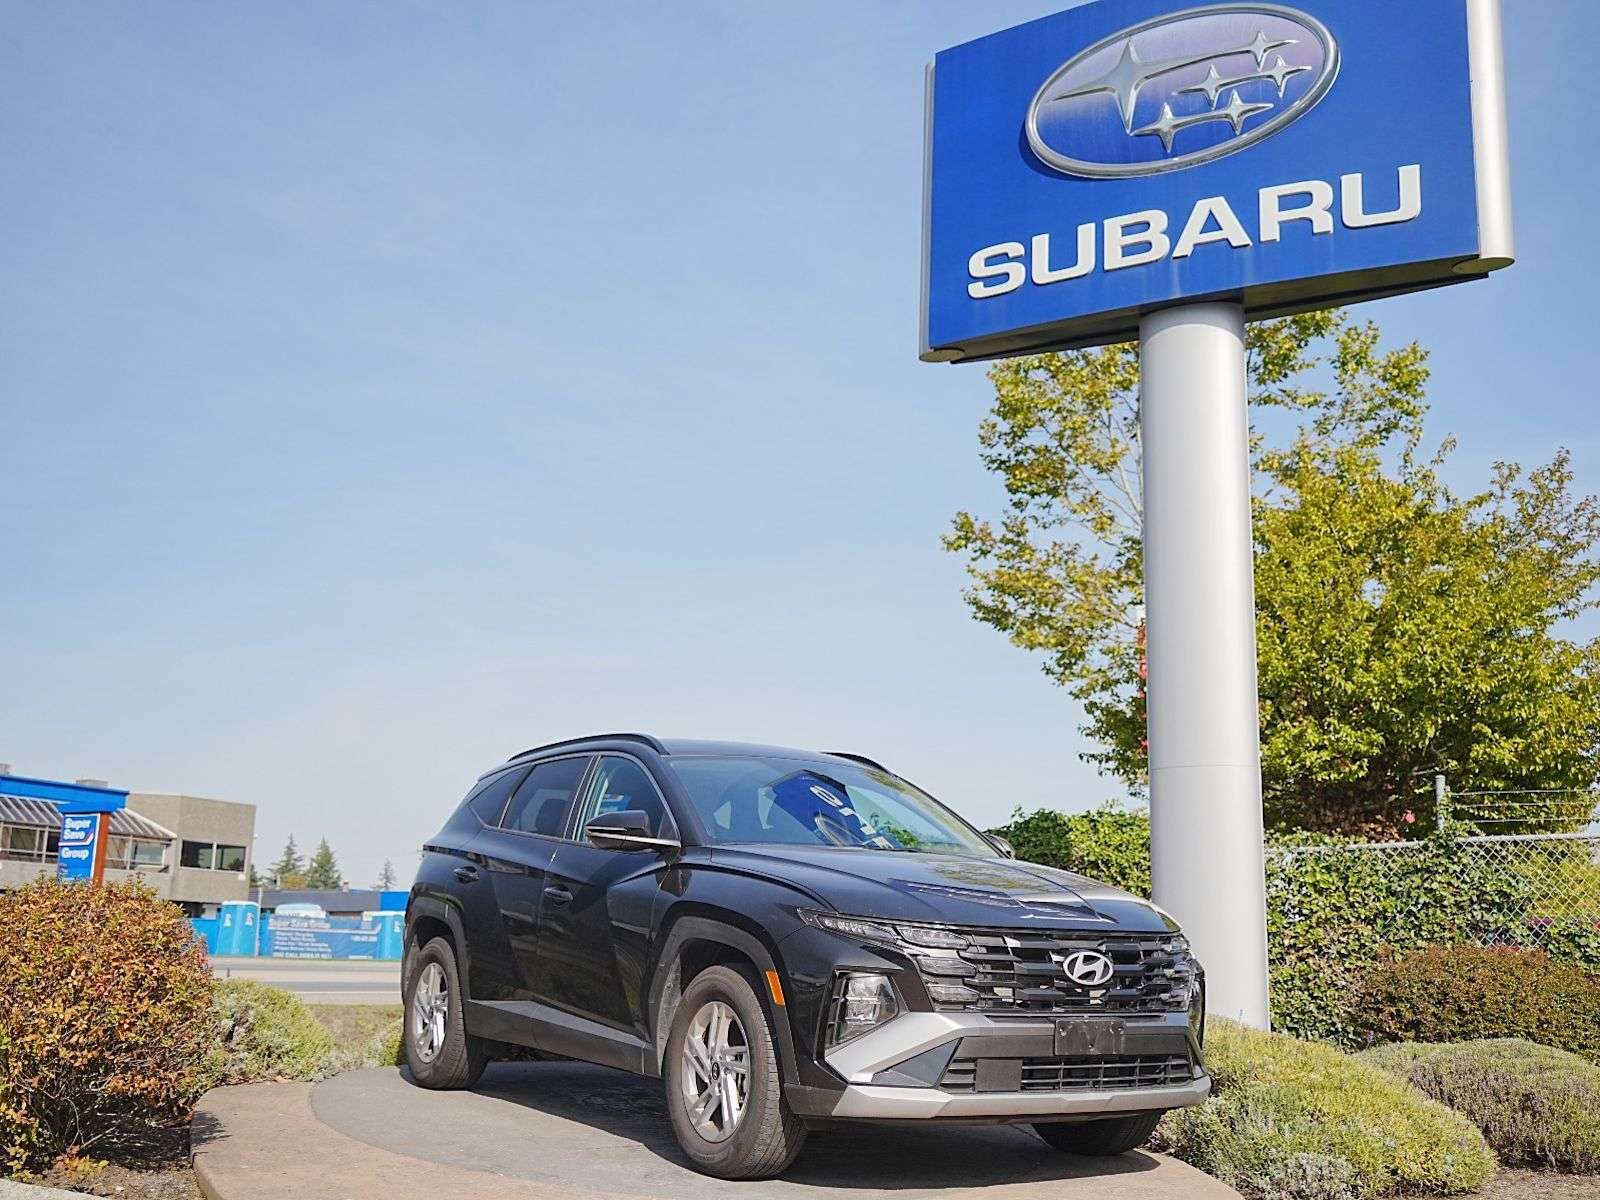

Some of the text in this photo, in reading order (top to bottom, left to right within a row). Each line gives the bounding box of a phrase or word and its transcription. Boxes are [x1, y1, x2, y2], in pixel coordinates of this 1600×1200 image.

[967, 164, 1422, 299] SUBARU
[65, 817, 92, 830] Super
[63, 829, 86, 840] Save
[61, 847, 90, 860] Group
